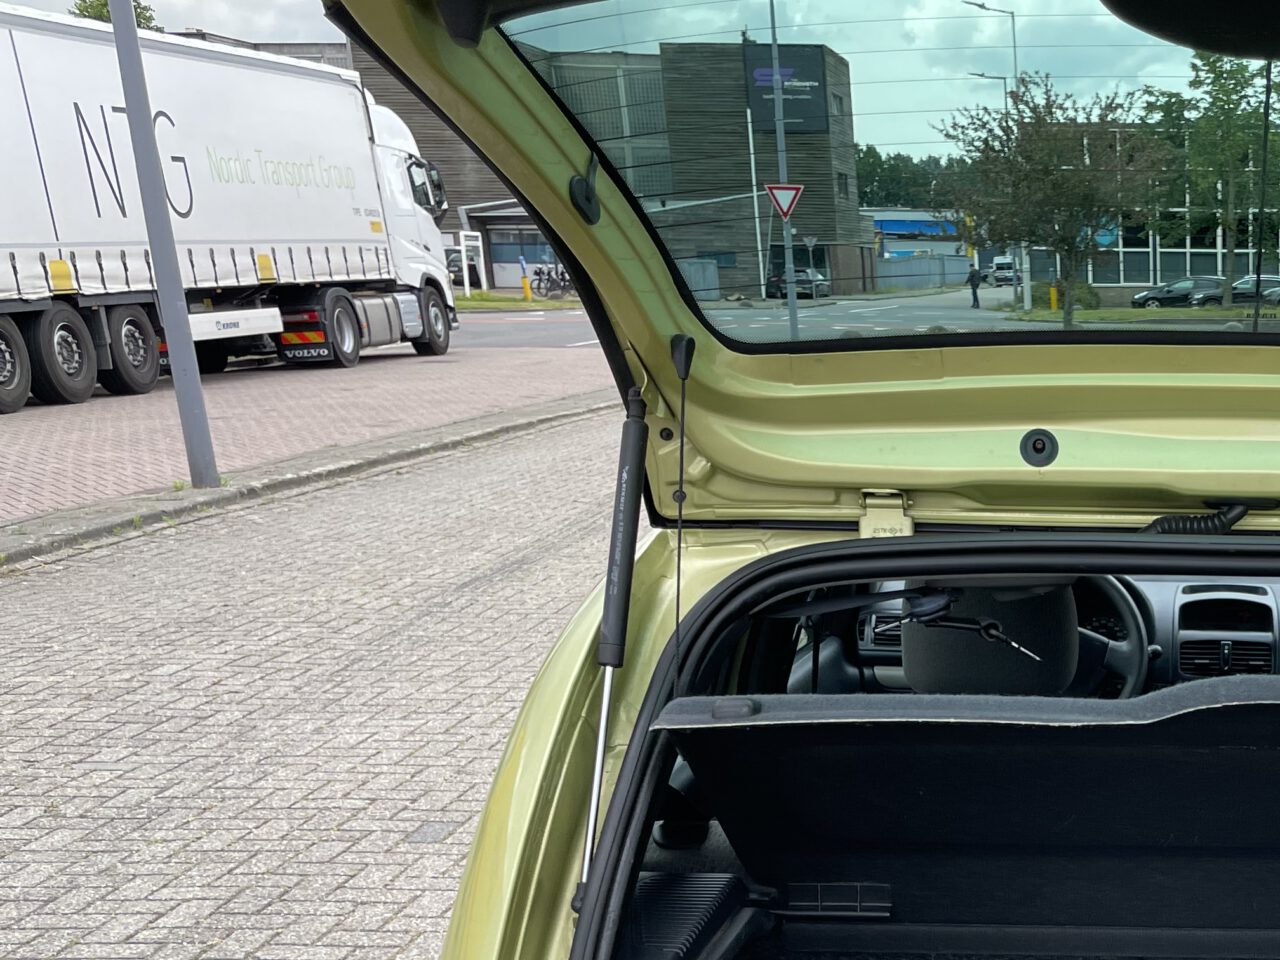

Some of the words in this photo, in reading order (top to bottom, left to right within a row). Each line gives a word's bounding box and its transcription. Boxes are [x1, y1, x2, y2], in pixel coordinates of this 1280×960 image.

[73, 101, 194, 219] NG
[206, 146, 256, 185] Nordic
[254, 149, 319, 199] Transport
[318, 155, 357, 200] Group
[285, 348, 329, 358] VOLVO
